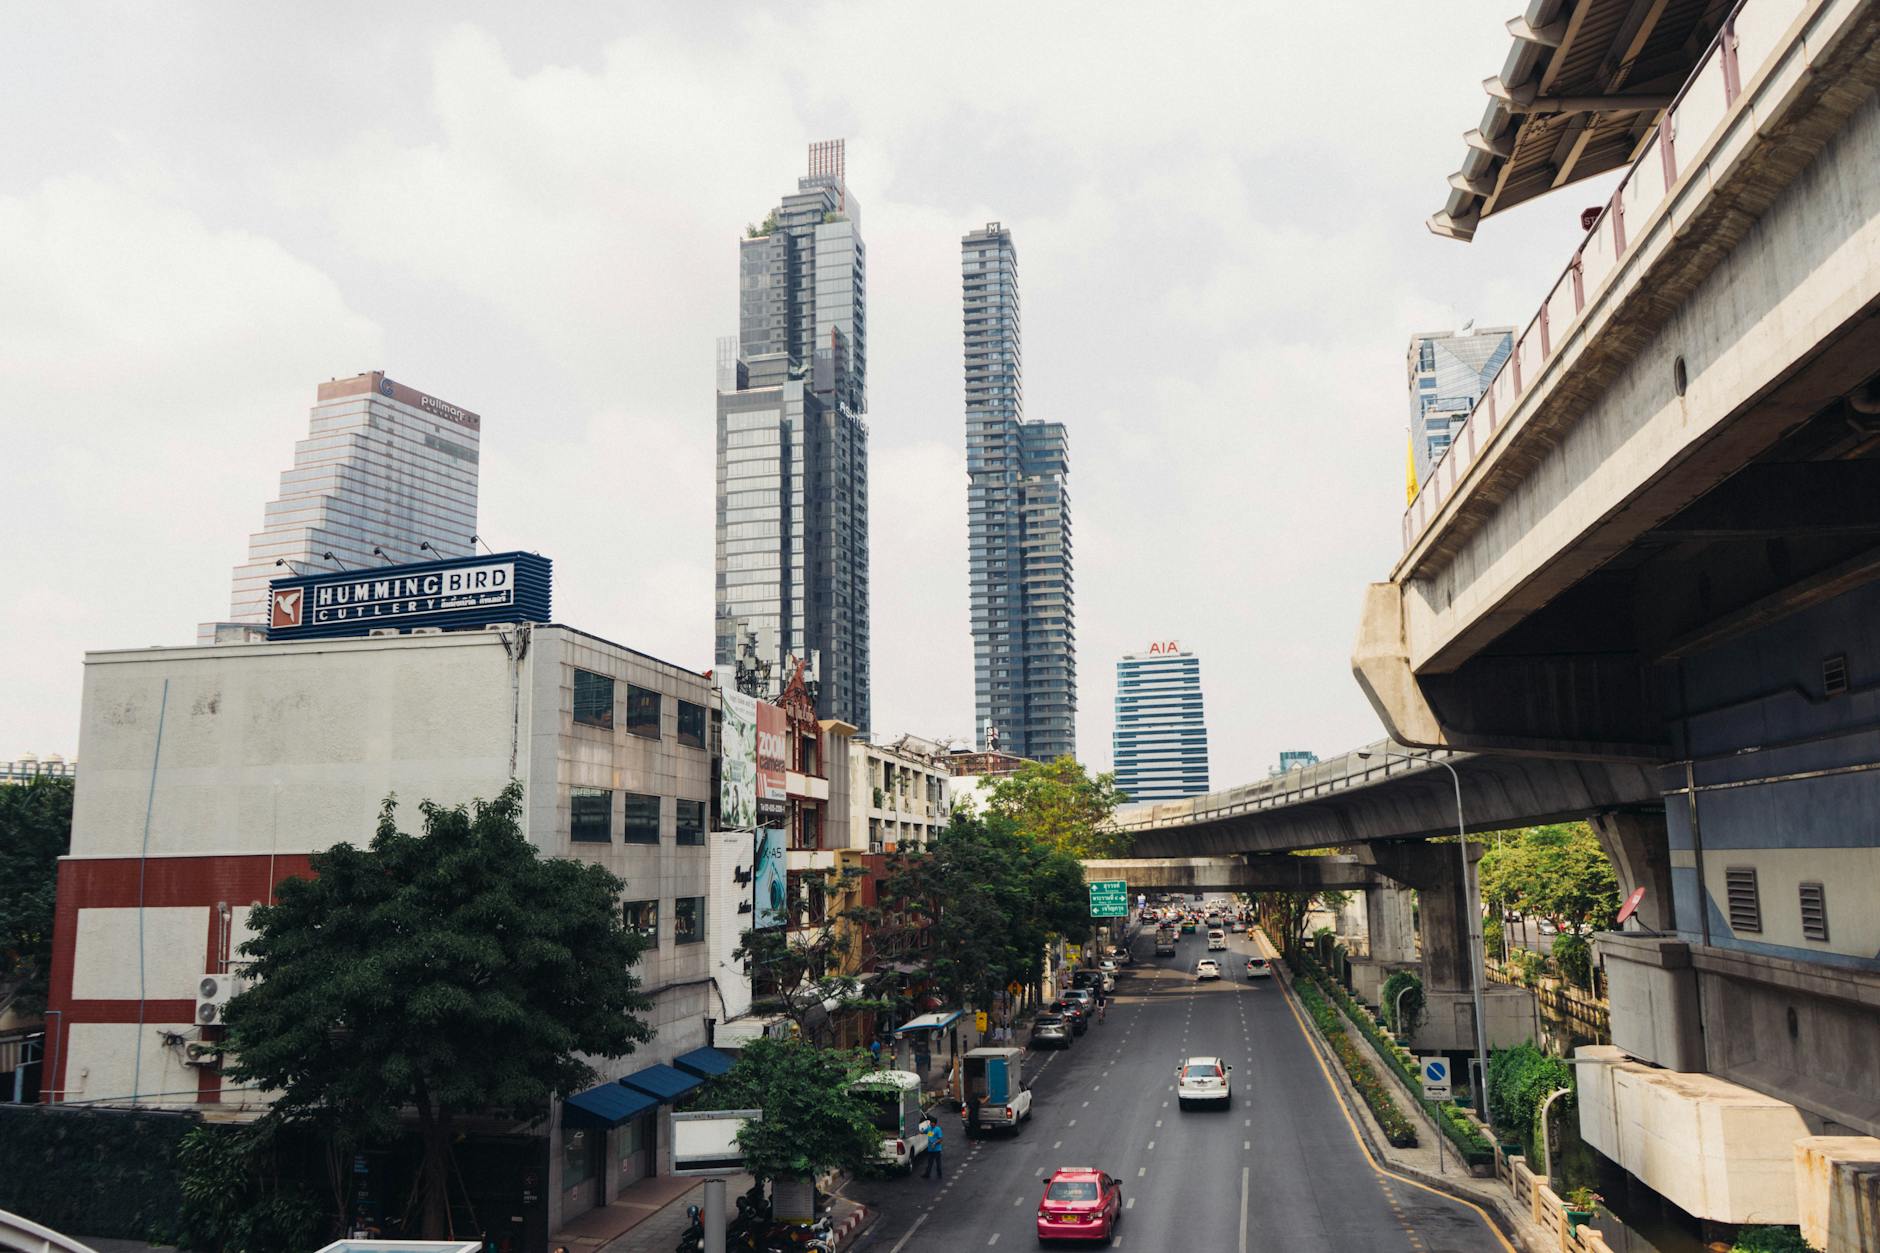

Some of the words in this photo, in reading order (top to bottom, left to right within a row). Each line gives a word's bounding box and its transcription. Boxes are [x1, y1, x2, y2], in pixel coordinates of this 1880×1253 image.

[421, 396, 465, 421] pullman
[319, 600, 436, 621] CUTLERY
[1150, 641, 1178, 655] AIA
[759, 731, 786, 761] ZOOM
[986, 727, 995, 751] SPA
[760, 755, 786, 773] camera
